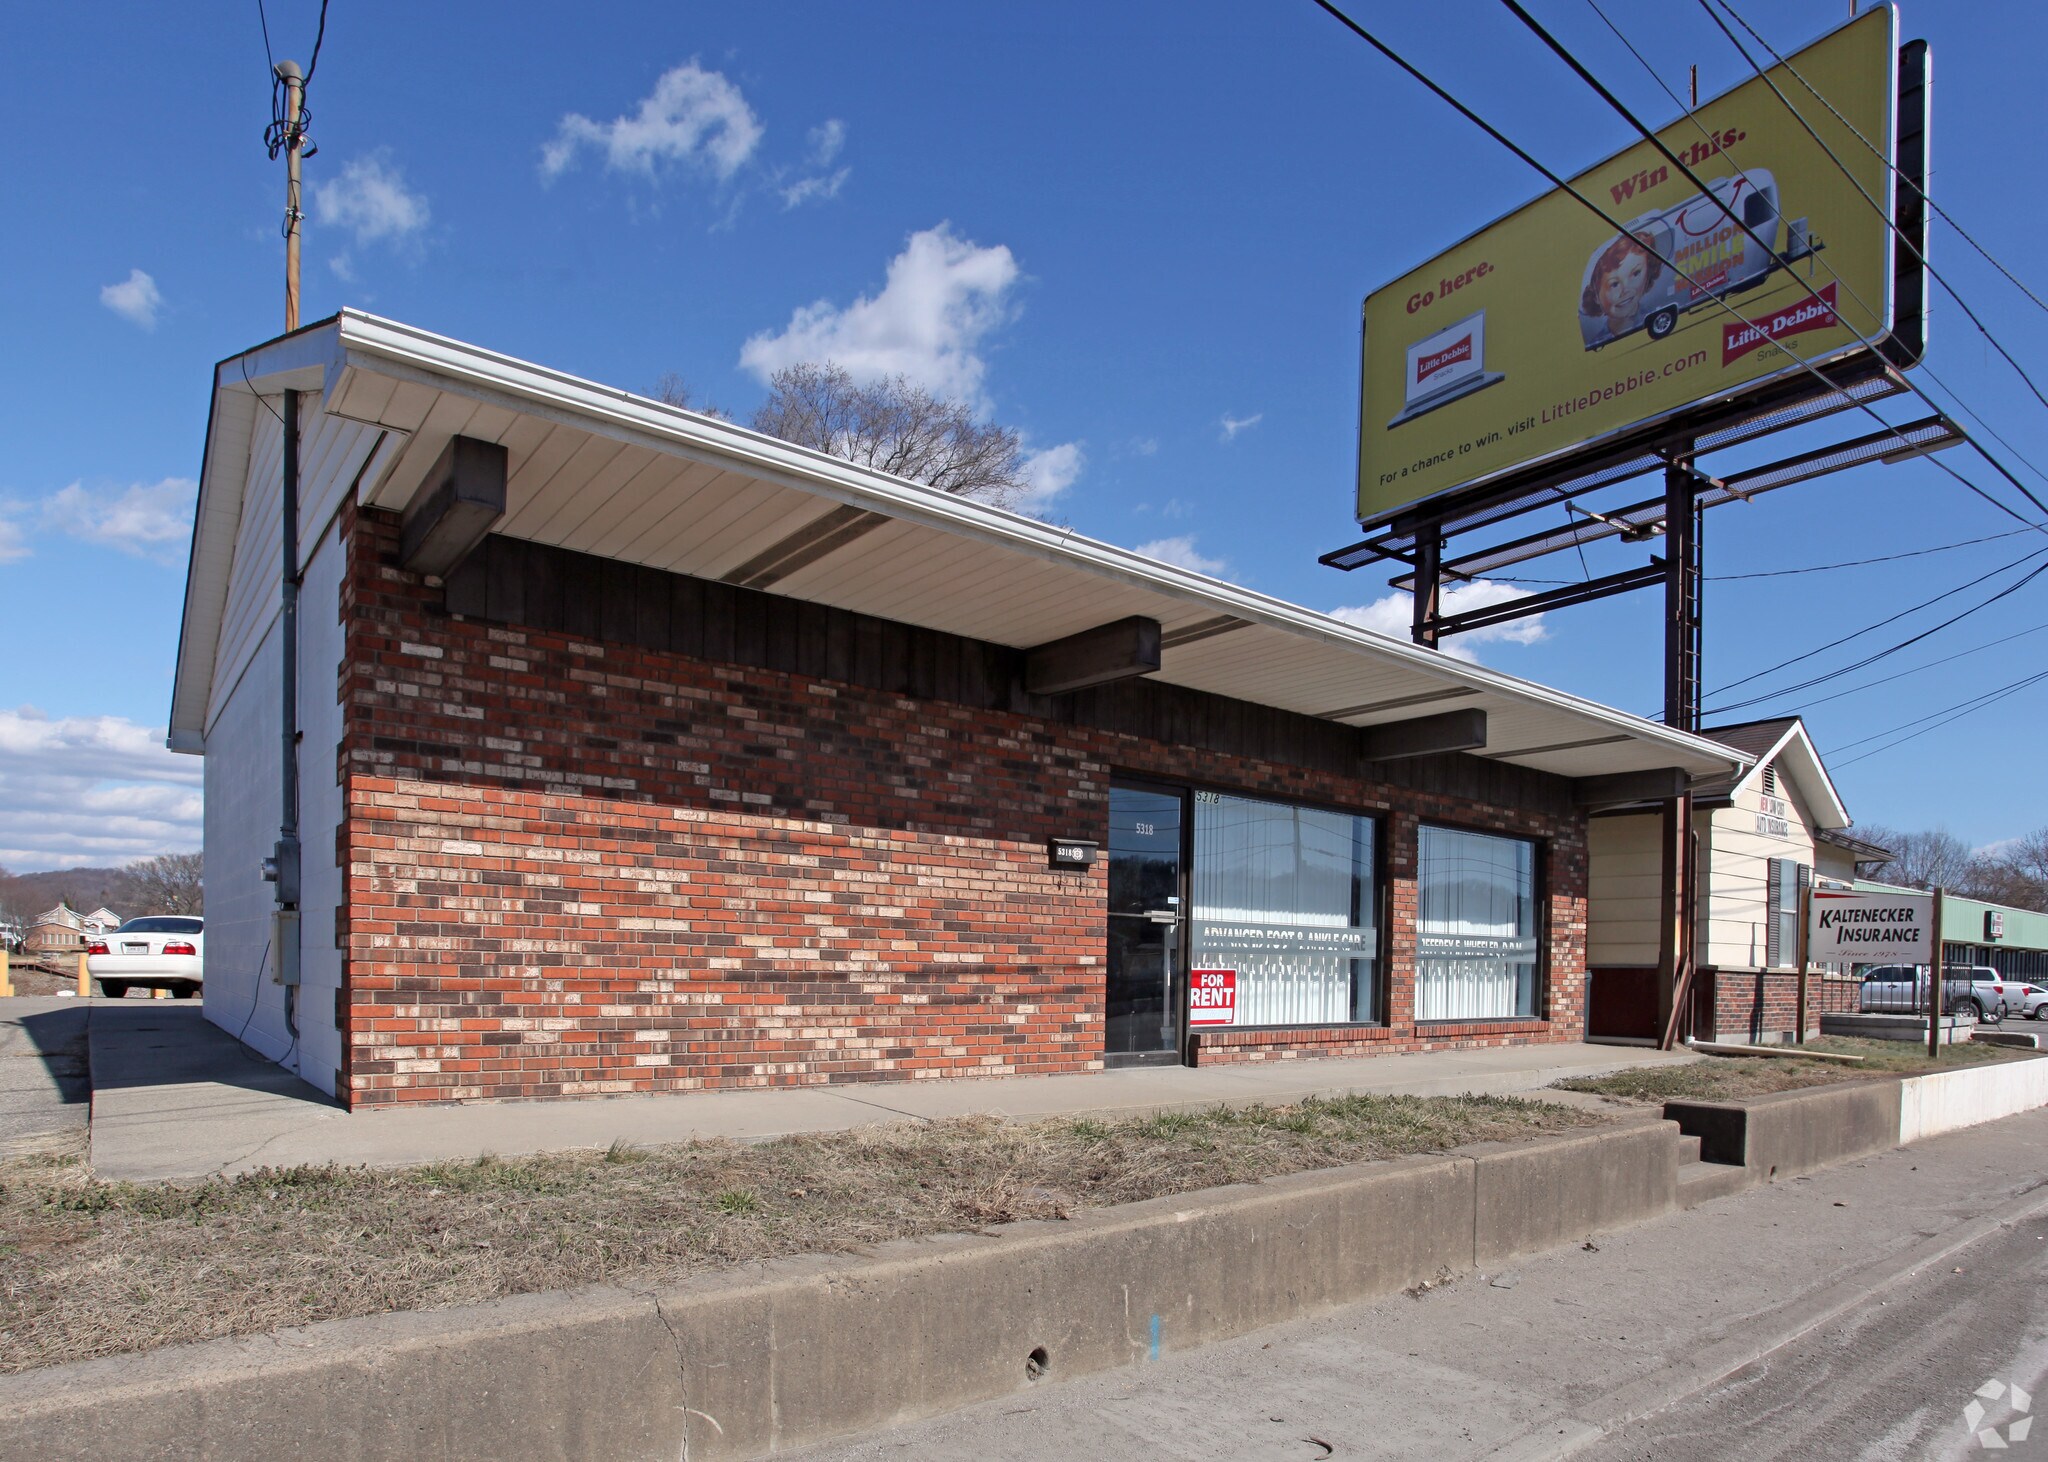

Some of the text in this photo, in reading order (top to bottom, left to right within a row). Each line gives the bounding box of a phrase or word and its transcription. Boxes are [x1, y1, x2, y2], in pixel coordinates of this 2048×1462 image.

[1610, 128, 1746, 205] Win this.
[1674, 233, 1745, 280] SMILE
[1406, 261, 1495, 314] Go here.
[1727, 325, 1769, 350] Little
[1419, 344, 1470, 374] Little Debbie
[1379, 471, 1398, 486] For
[1401, 467, 1408, 478] a
[1412, 448, 1455, 473] chance
[1459, 442, 1472, 456] to
[1507, 416, 1536, 436] visit
[1541, 349, 1707, 424] LittleDebbie.com
[1196, 791, 1220, 804] 5318
[1136, 823, 1154, 836] 5318
[1057, 847, 1072, 857] 5318
[1819, 908, 1914, 928] KALTENECKER
[1836, 926, 1920, 944] INSURANCE
[1838, 949, 1869, 957] Since
[1201, 973, 1224, 987] FOR
[1190, 987, 1234, 1006] RENT
